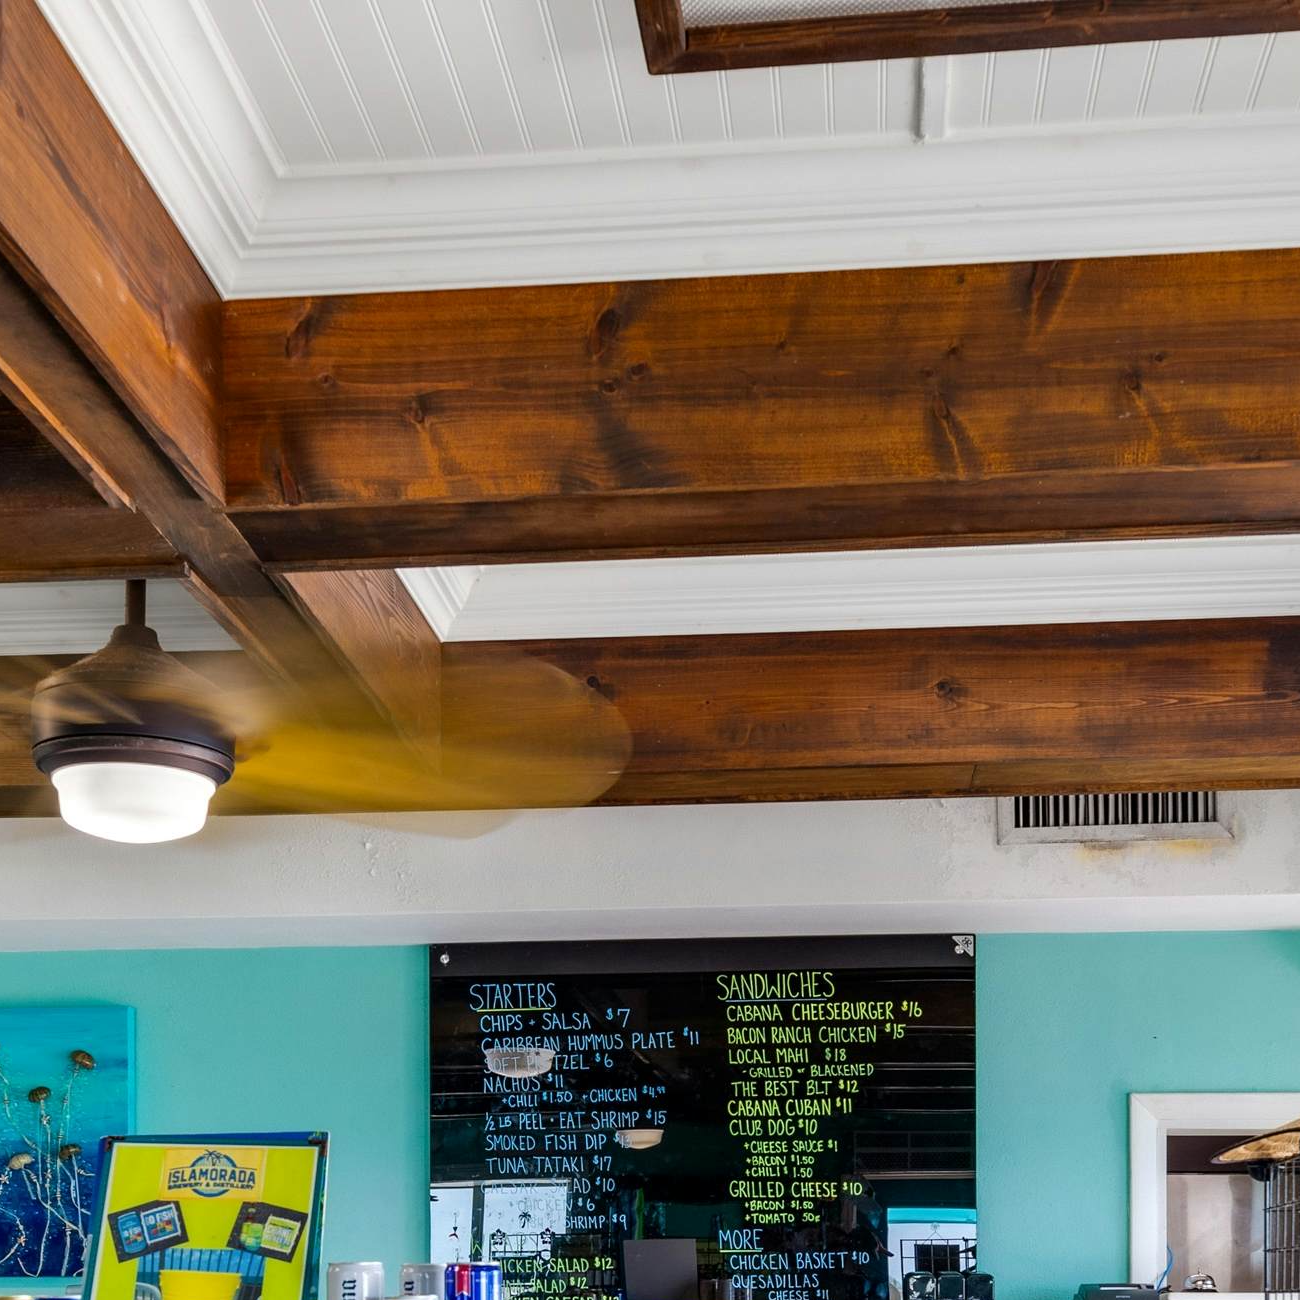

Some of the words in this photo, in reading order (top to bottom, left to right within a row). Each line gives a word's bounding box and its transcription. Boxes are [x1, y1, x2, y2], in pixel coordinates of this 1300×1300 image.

[717, 972, 835, 1000] SANDWICHES
[469, 983, 556, 1011] STARTERS
[727, 1005, 783, 1022] CABANA
[792, 1002, 894, 1020] CHEESEBURGER
[901, 1000, 922, 1017] $16
[480, 1015, 522, 1032] CHIPS
[542, 1013, 591, 1030] SALSA
[481, 1036, 560, 1053] CARIBBEAN
[568, 1034, 624, 1050] HUMMUS
[632, 1031, 676, 1049] PLATE
[683, 1027, 699, 1045] $11
[727, 1028, 766, 1044] BACON
[772, 1026, 811, 1043] RANCH
[819, 1026, 877, 1043] CHICKEN
[885, 1023, 906, 1039] $15
[595, 1054, 613, 1068] $6
[729, 1049, 771, 1064] LOCAL
[777, 1049, 808, 1063] MAHI
[825, 1048, 846, 1061] $18
[811, 1064, 874, 1076] BLACKENED
[483, 1076, 540, 1093] NACHOS
[547, 1073, 563, 1088] $11
[732, 1082, 757, 1097] THE
[765, 1081, 799, 1096] BEST
[807, 1081, 832, 1095] BLT
[838, 1080, 859, 1093] $12
[542, 1091, 572, 1103] $1.50
[728, 1100, 780, 1116] CABANA
[786, 1099, 831, 1116] CUBAN
[836, 1097, 852, 1113] $11
[500, 1116, 512, 1127] LB
[519, 1114, 545, 1130] PEEL
[560, 1112, 585, 1129] EAT
[591, 1111, 639, 1129] SHRIMP
[646, 1109, 666, 1125] $15
[729, 1120, 763, 1136] CLUB
[769, 1119, 795, 1135] DOG
[799, 1119, 817, 1134] $10
[485, 1135, 535, 1150] SMOKED
[545, 1134, 576, 1150] FISH
[586, 1134, 606, 1150] DIP
[792, 1140, 824, 1152] SAUCE
[828, 1140, 837, 1152] $1
[486, 1158, 526, 1174] TUNA
[533, 1156, 584, 1173] TATAKI
[593, 1155, 612, 1171] $17
[791, 1155, 814, 1164] $1.50
[168, 1168, 256, 1184] ISLAMORADA
[595, 1177, 615, 1192] $10
[729, 1180, 784, 1198] GRILLED
[792, 1182, 838, 1198] CHEESE
[843, 1182, 862, 1195] $10
[577, 1198, 594, 1210] $6
[791, 1201, 813, 1209] $1.50
[565, 1215, 605, 1229] SHRIMP
[612, 1214, 627, 1230] $9
[719, 1229, 763, 1250] MORE
[550, 1258, 589, 1272] SALAD
[594, 1257, 613, 1269] $12
[730, 1254, 788, 1270] CHICKEN
[796, 1252, 848, 1269] BASKET
[852, 1252, 869, 1264] $10
[570, 1277, 588, 1289] $12
[732, 1274, 819, 1289] QUESADILLAS
[769, 1290, 809, 1300] CHEESE
[817, 1289, 828, 1300] $11
